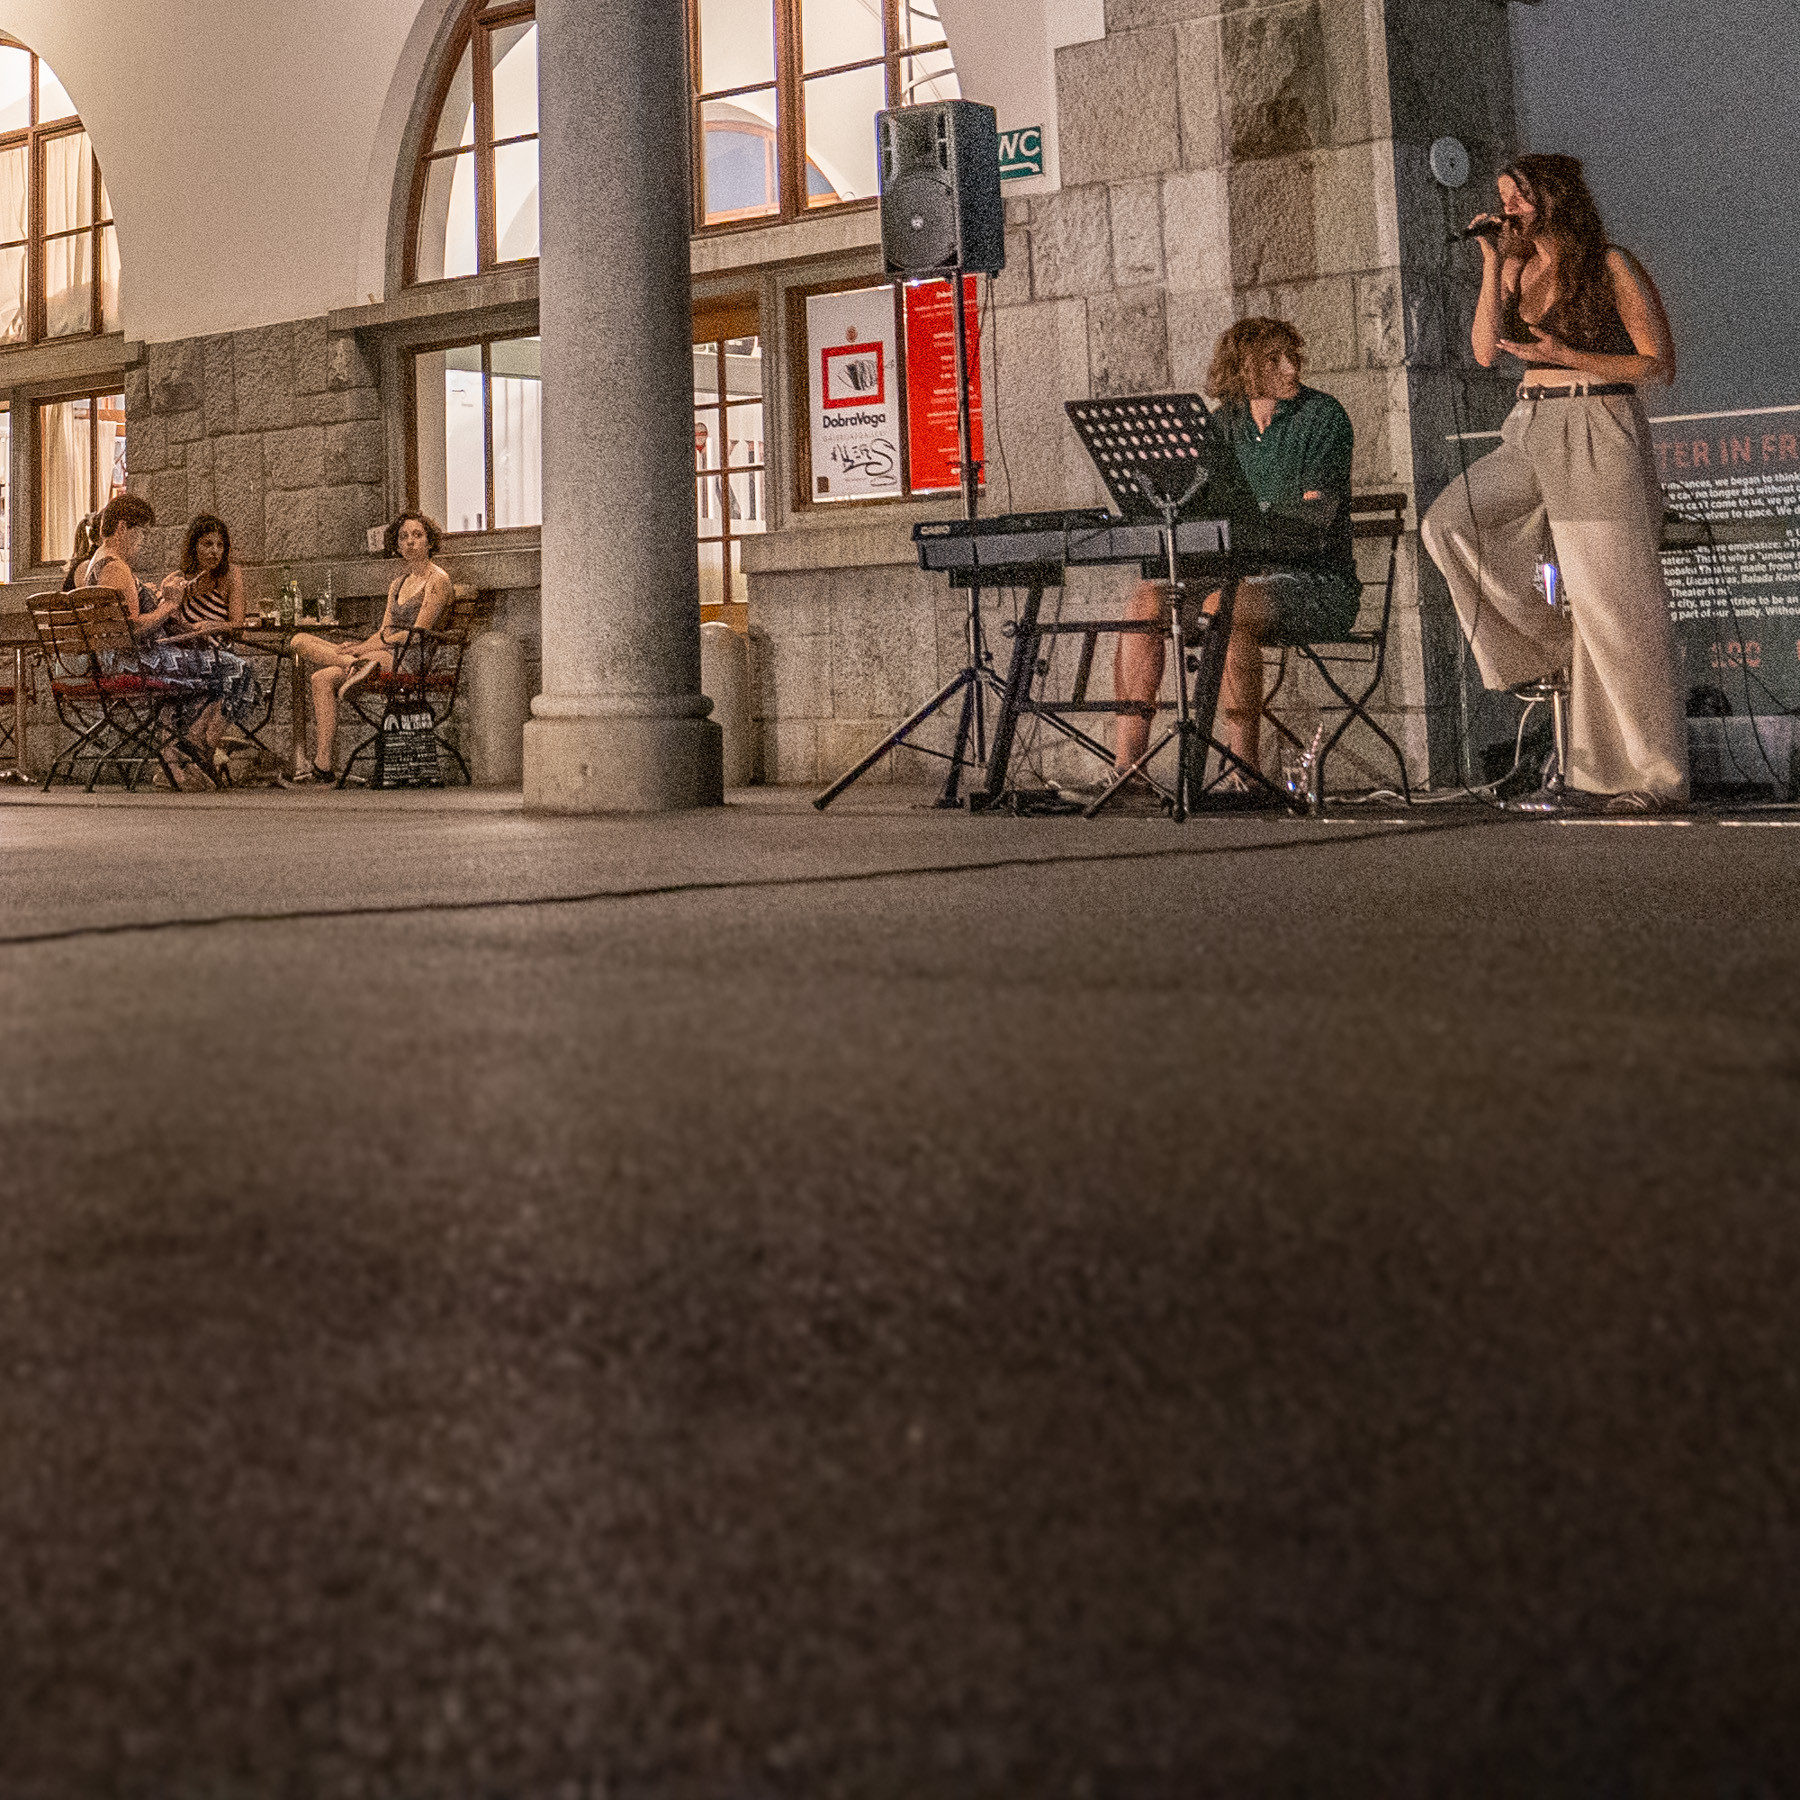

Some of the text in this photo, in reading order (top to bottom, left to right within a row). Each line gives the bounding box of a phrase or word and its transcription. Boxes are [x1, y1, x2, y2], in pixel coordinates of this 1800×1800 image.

[998, 129, 1041, 162] WC
[822, 411, 886, 429] DobraVaga
[1720, 435, 1752, 465] IN
[1730, 476, 1760, 490] began
[1762, 474, 1773, 484] to
[1709, 488, 1740, 500] longer
[1741, 485, 1755, 496] do
[1756, 484, 1794, 496] without
[1710, 500, 1737, 509] come
[1738, 498, 1750, 508] to
[1766, 497, 1782, 505] we
[1783, 496, 1797, 507] go
[1731, 509, 1743, 519] to
[1775, 505, 1792, 516] We
[1727, 553, 1748, 564] why
[1768, 561, 1793, 572] from
[1670, 587, 1706, 598] Theater
[1758, 595, 1770, 606] to
[1771, 594, 1785, 604] be
[1679, 609, 1699, 621] part
[1700, 607, 1711, 618] of
